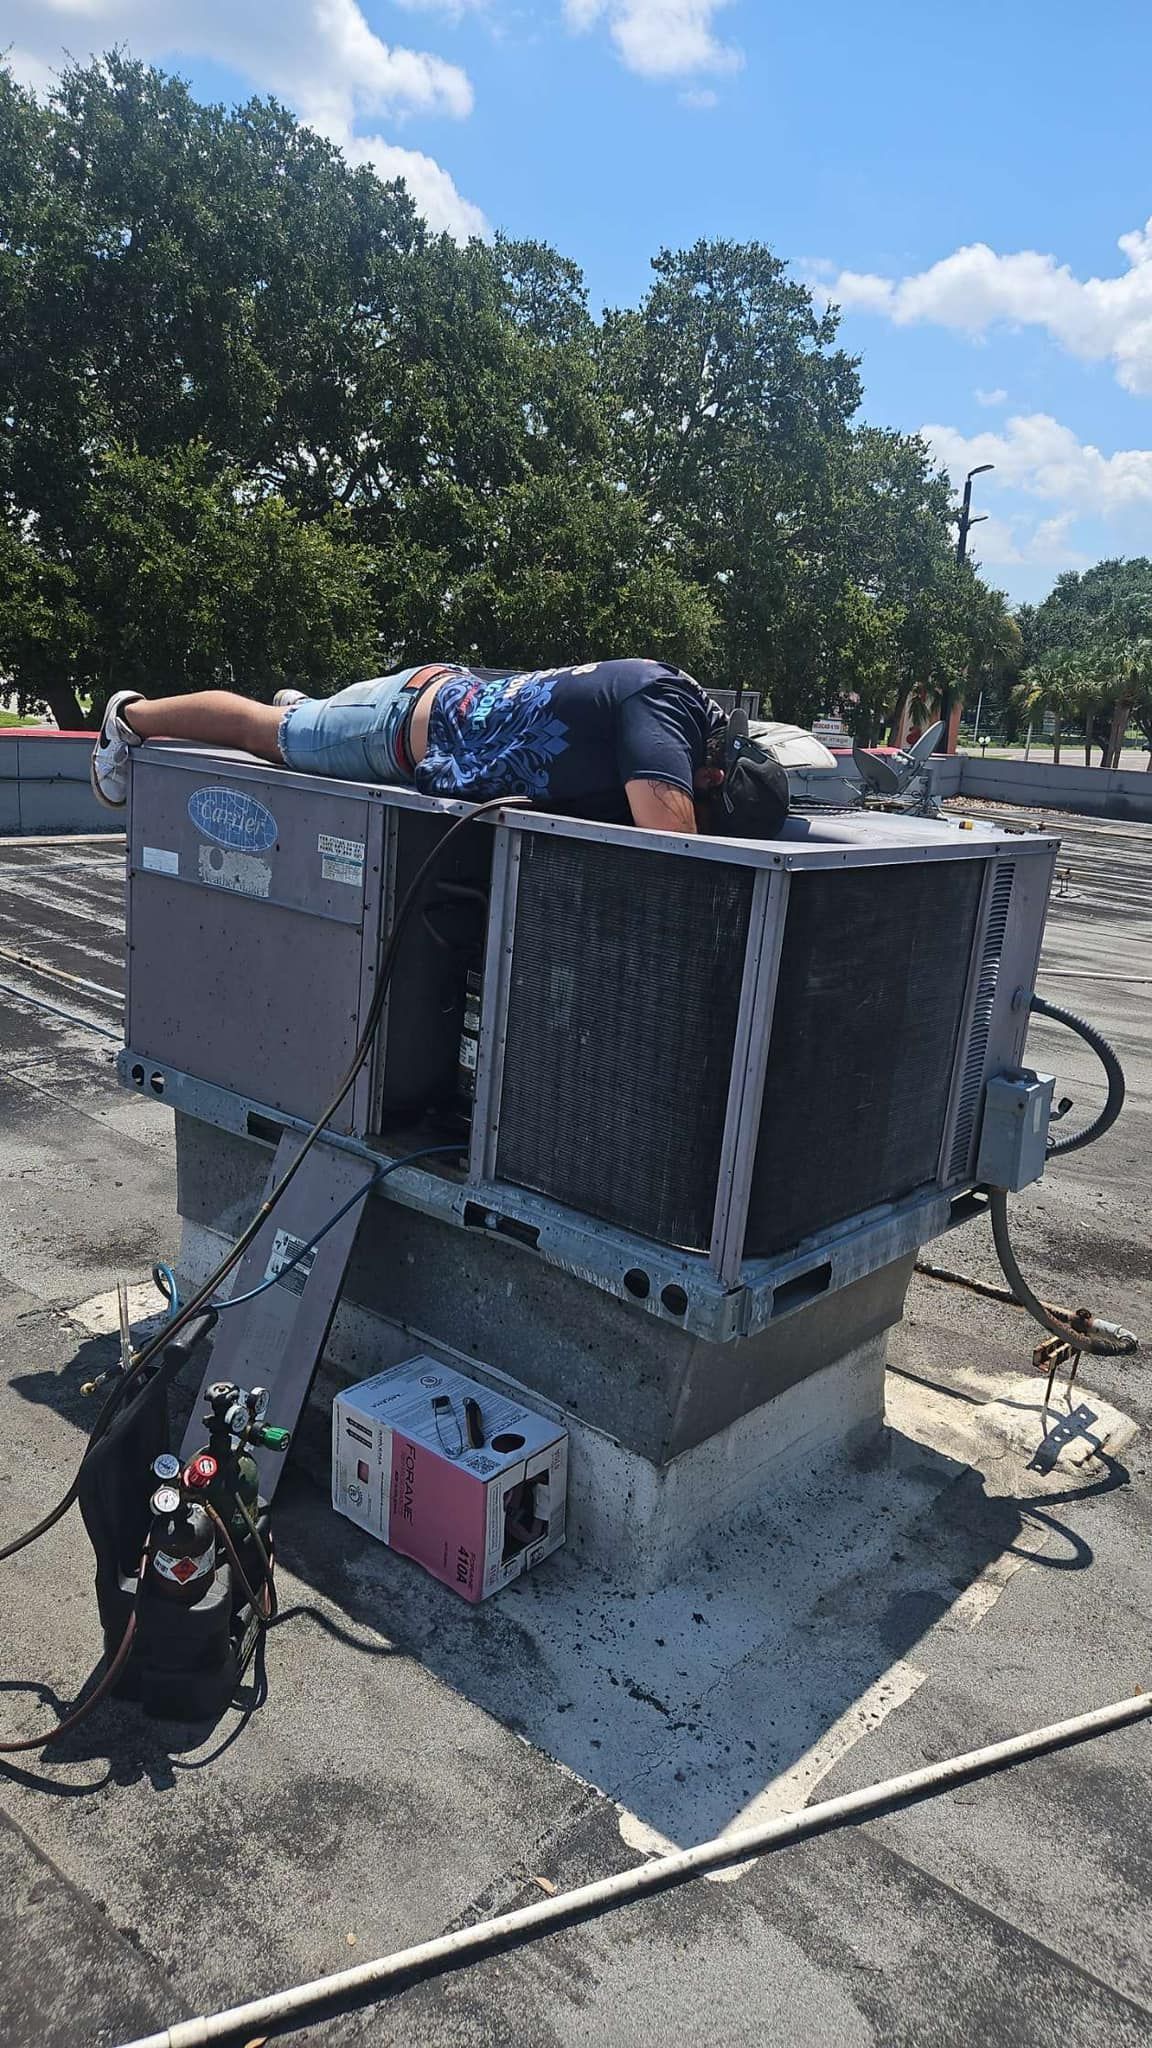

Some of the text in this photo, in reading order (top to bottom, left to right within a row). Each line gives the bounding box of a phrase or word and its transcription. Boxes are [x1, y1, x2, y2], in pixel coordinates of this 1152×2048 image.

[201, 799, 267, 836] Carrier
[403, 1443, 416, 1521] FORANE
[455, 1545, 471, 1584] 410A
